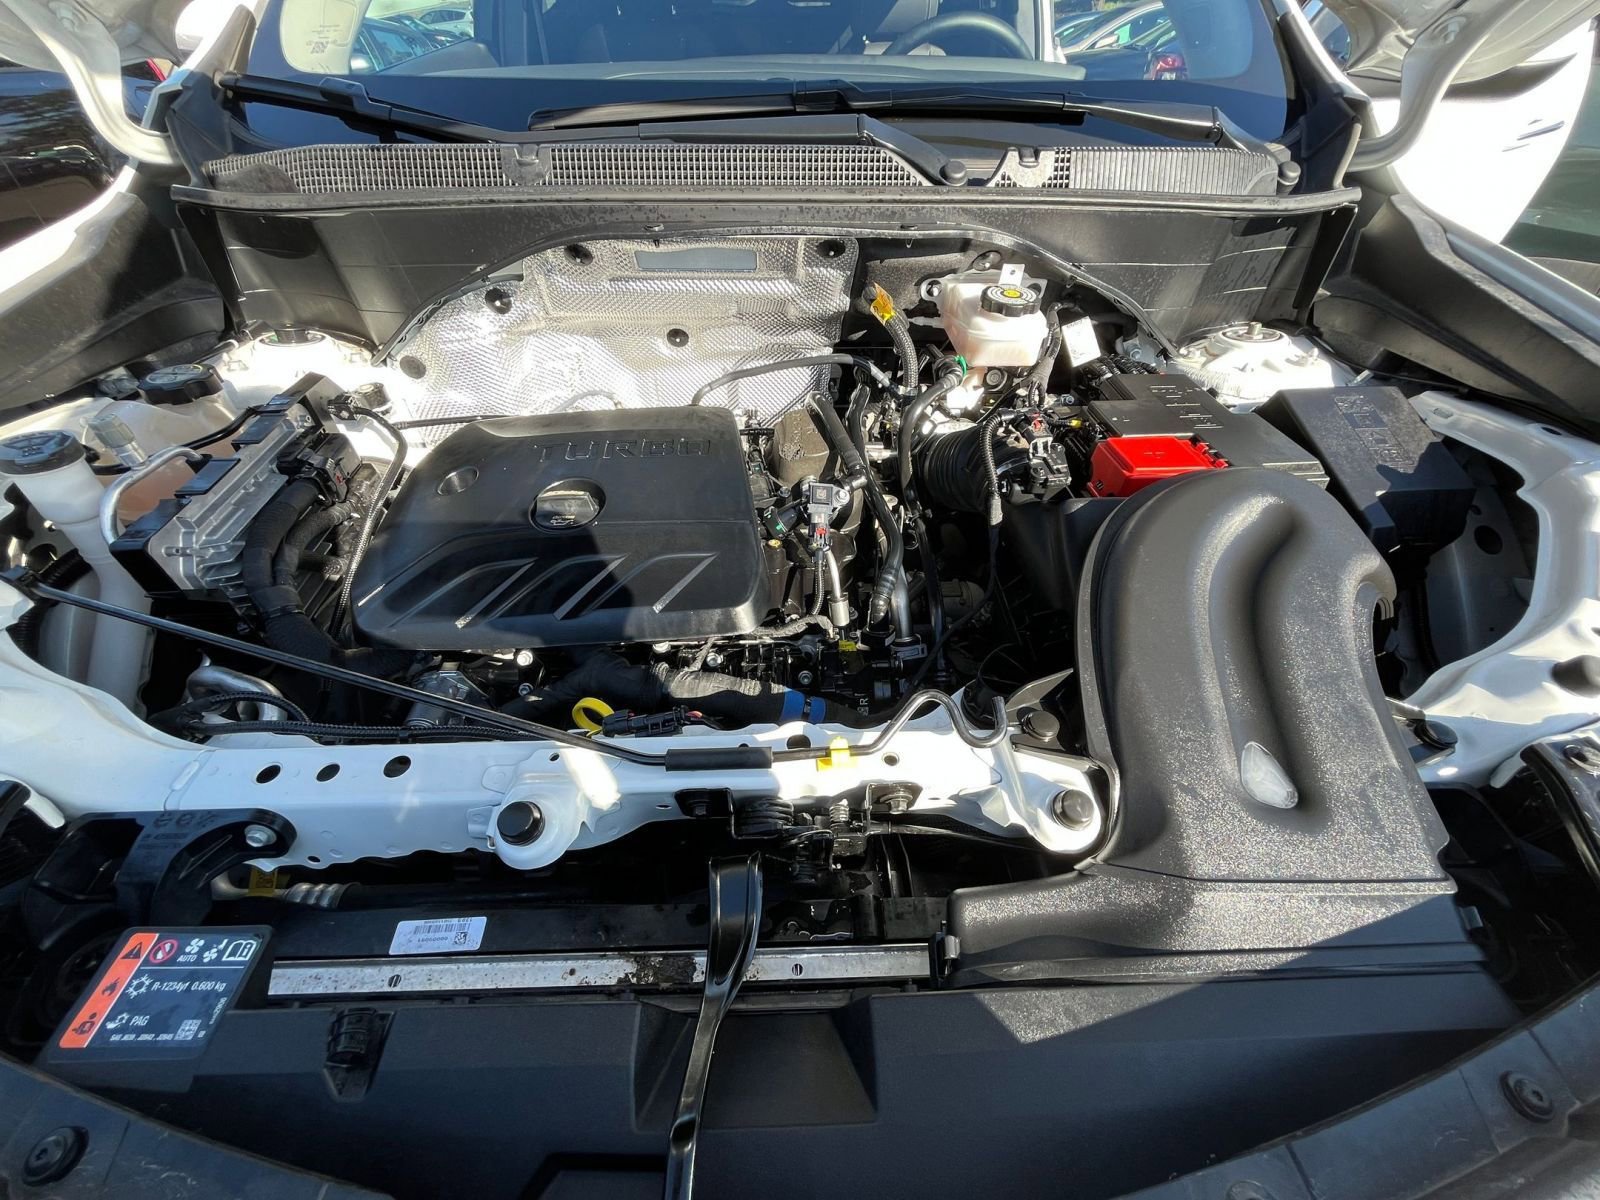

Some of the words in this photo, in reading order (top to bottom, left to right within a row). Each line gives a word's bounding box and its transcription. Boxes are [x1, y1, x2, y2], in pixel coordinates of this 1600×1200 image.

[533, 438, 711, 462] TURBO
[151, 982, 190, 992] R-1234yf
[191, 982, 216, 991] 0.600
[214, 982, 227, 992] kg
[129, 1015, 150, 1026] PAG
